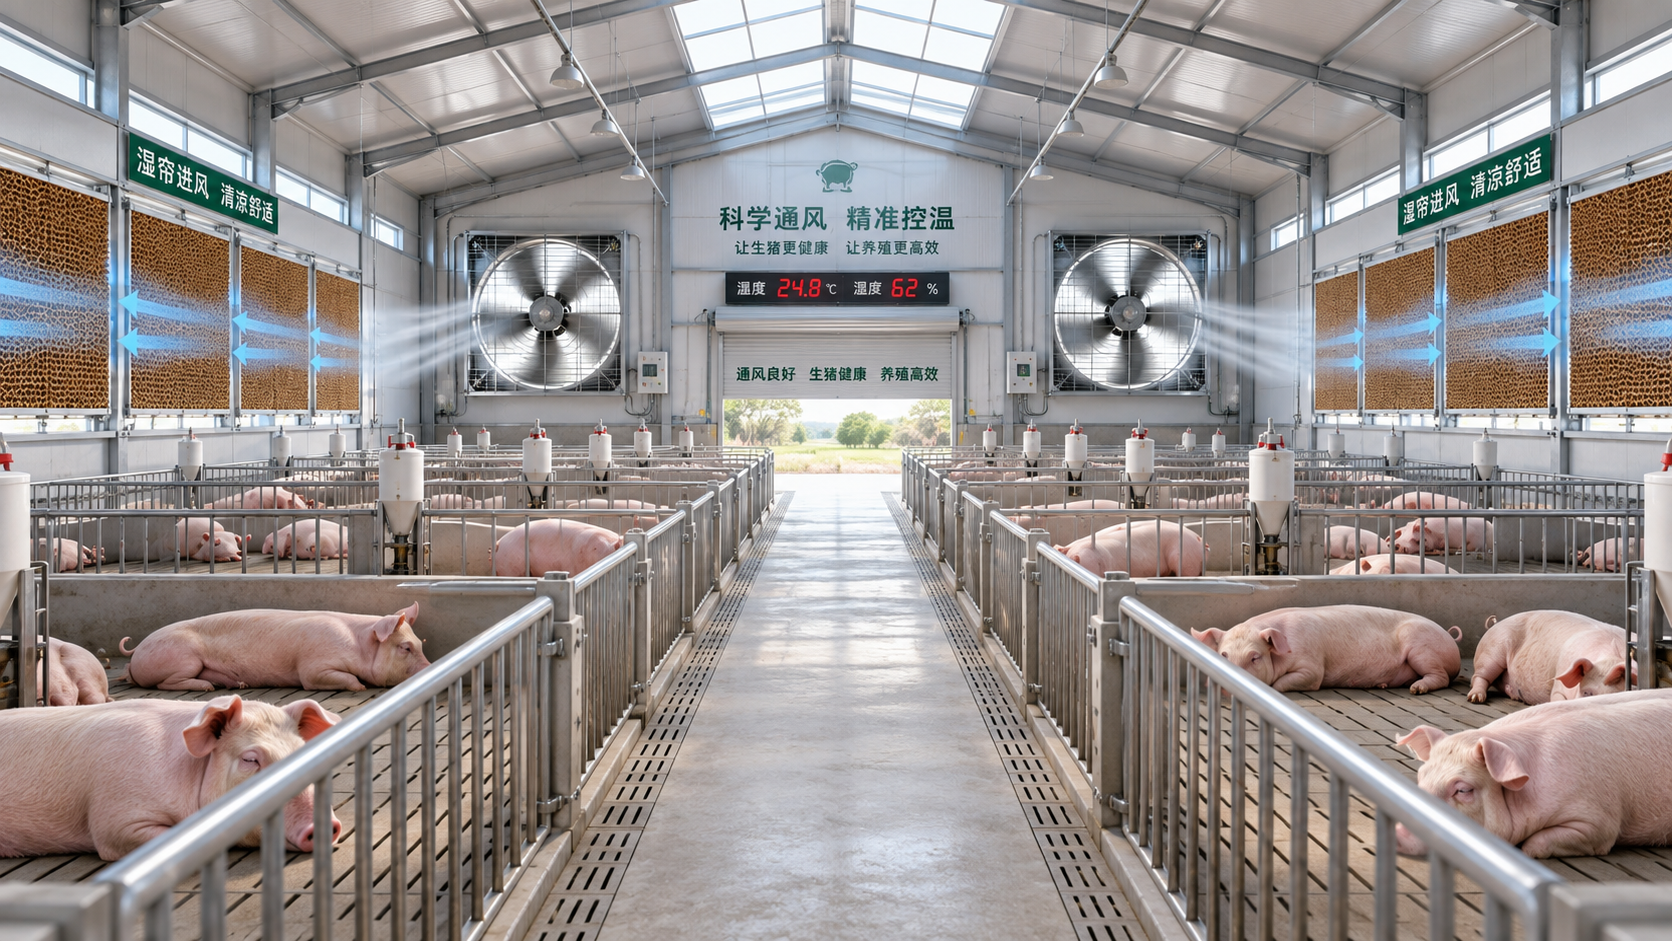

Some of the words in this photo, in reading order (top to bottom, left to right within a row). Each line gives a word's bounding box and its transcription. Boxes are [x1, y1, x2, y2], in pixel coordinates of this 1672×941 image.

[137, 146, 209, 199] 湿帘进风
[221, 182, 274, 224] 清凉舒适
[1403, 182, 1459, 225] 湿帘进风
[1470, 147, 1542, 199] 清凉舒适
[719, 206, 827, 231] 科学通风
[847, 206, 955, 231] 精准控温
[735, 240, 829, 255] 让生猪更健康
[846, 240, 940, 255] 让养殖更高效
[777, 278, 821, 298] 24.8
[891, 278, 918, 298] 62
[926, 283, 939, 295] %
[736, 366, 796, 382] 通风良好
[809, 366, 867, 382] 生猪健康
[881, 366, 939, 382] 养殖高效
